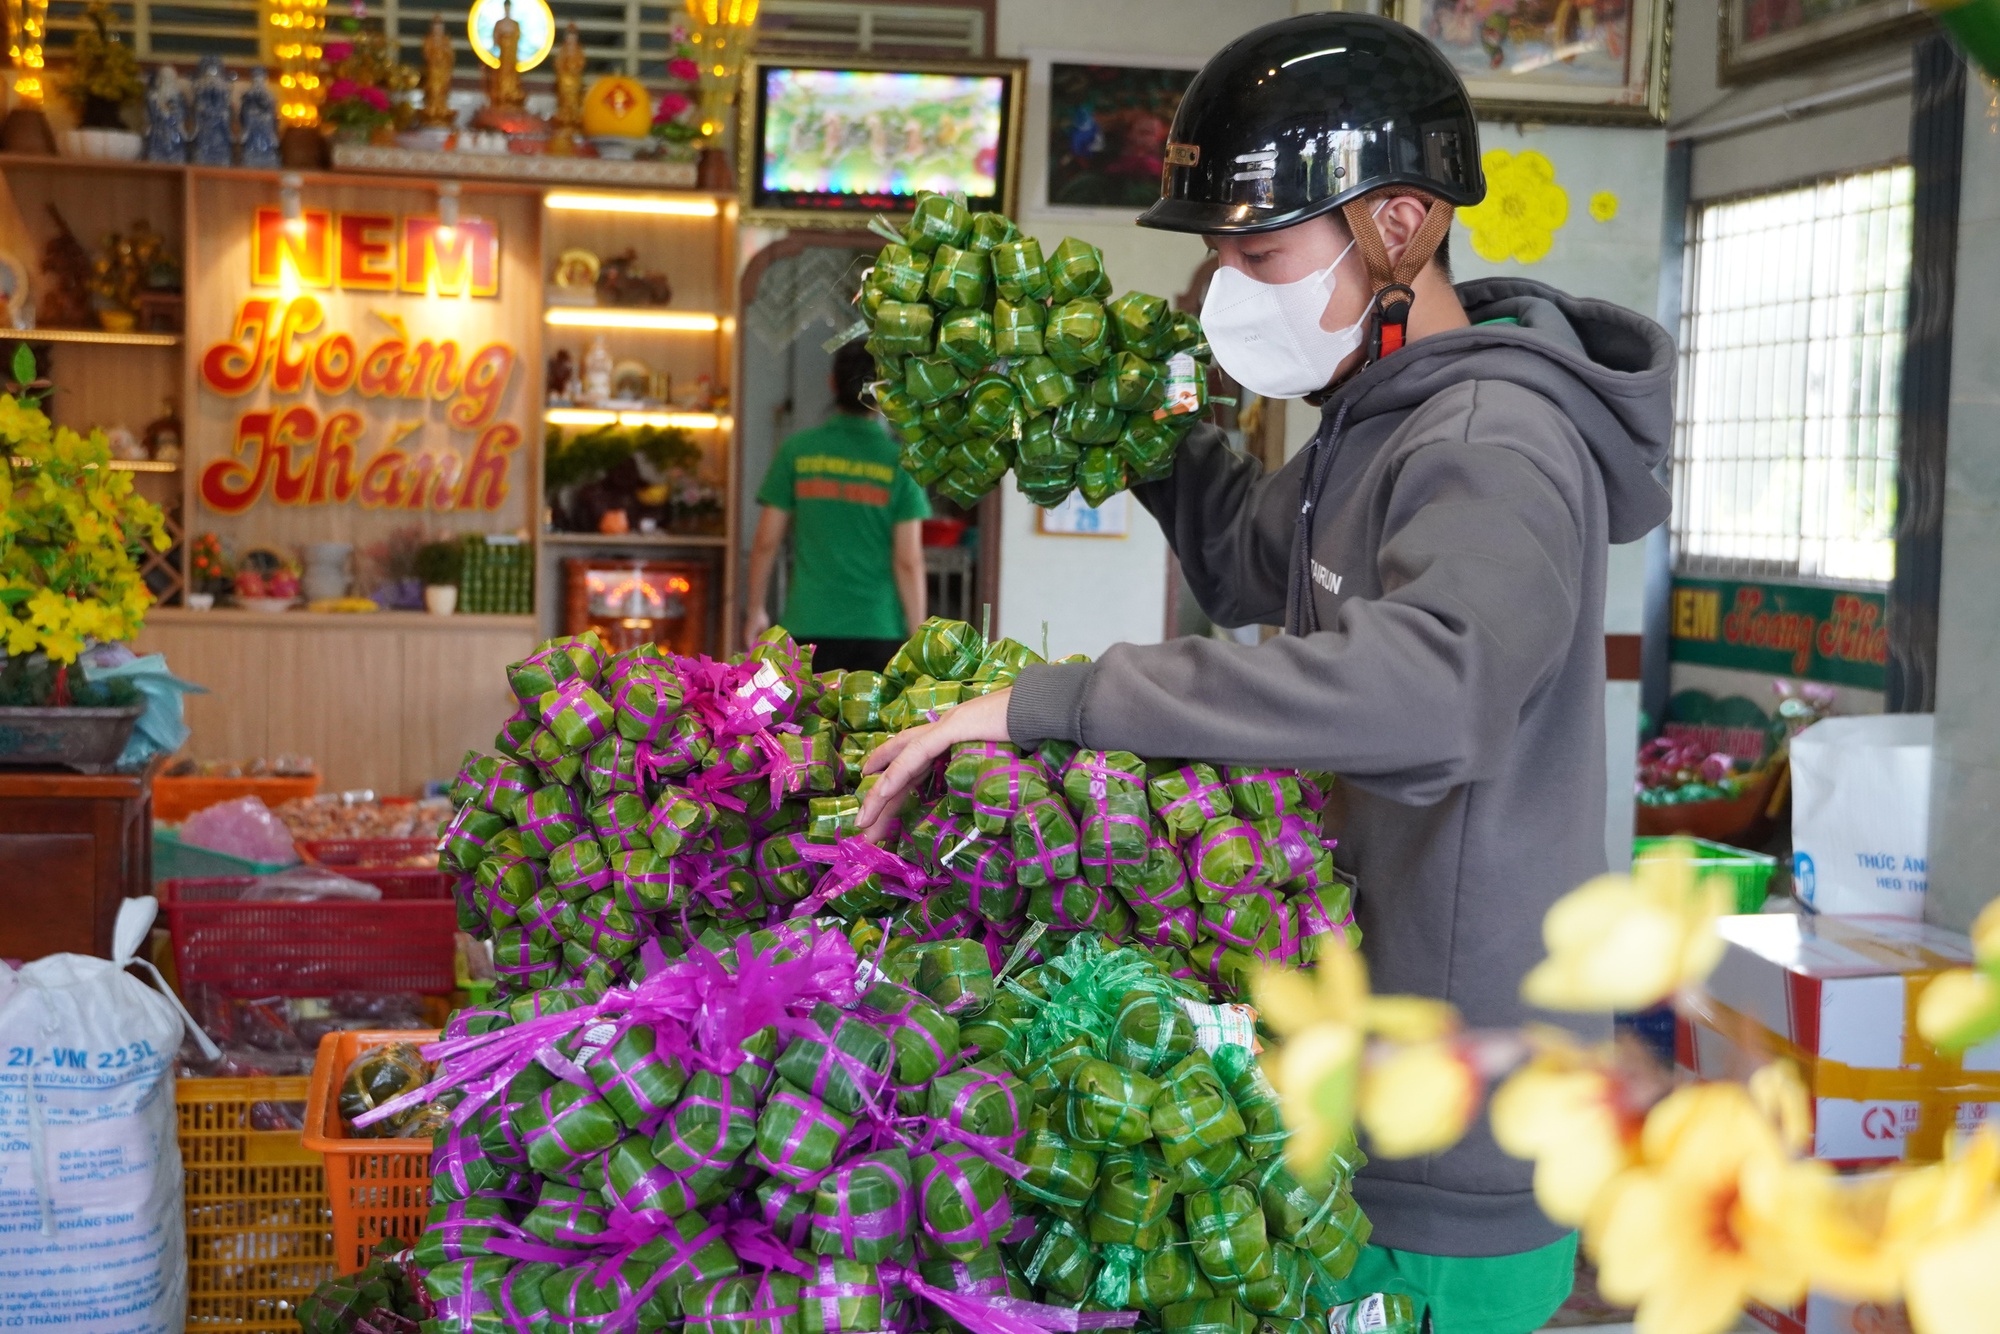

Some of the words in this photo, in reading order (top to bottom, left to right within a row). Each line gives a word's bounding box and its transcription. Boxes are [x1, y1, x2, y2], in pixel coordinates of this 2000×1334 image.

[252, 207, 500, 296] NEM
[202, 295, 514, 430] Hoàng
[200, 407, 521, 515] Khánh
[1673, 588, 1719, 641] EM
[98, 1038, 158, 1070] 223L
[20, 1073, 42, 1083] CN
[58, 1216, 102, 1230] KHÁNG
[106, 1212, 135, 1225] SINH
[28, 1311, 71, 1325] THÀNH
[75, 1306, 111, 1322] PHẦN
